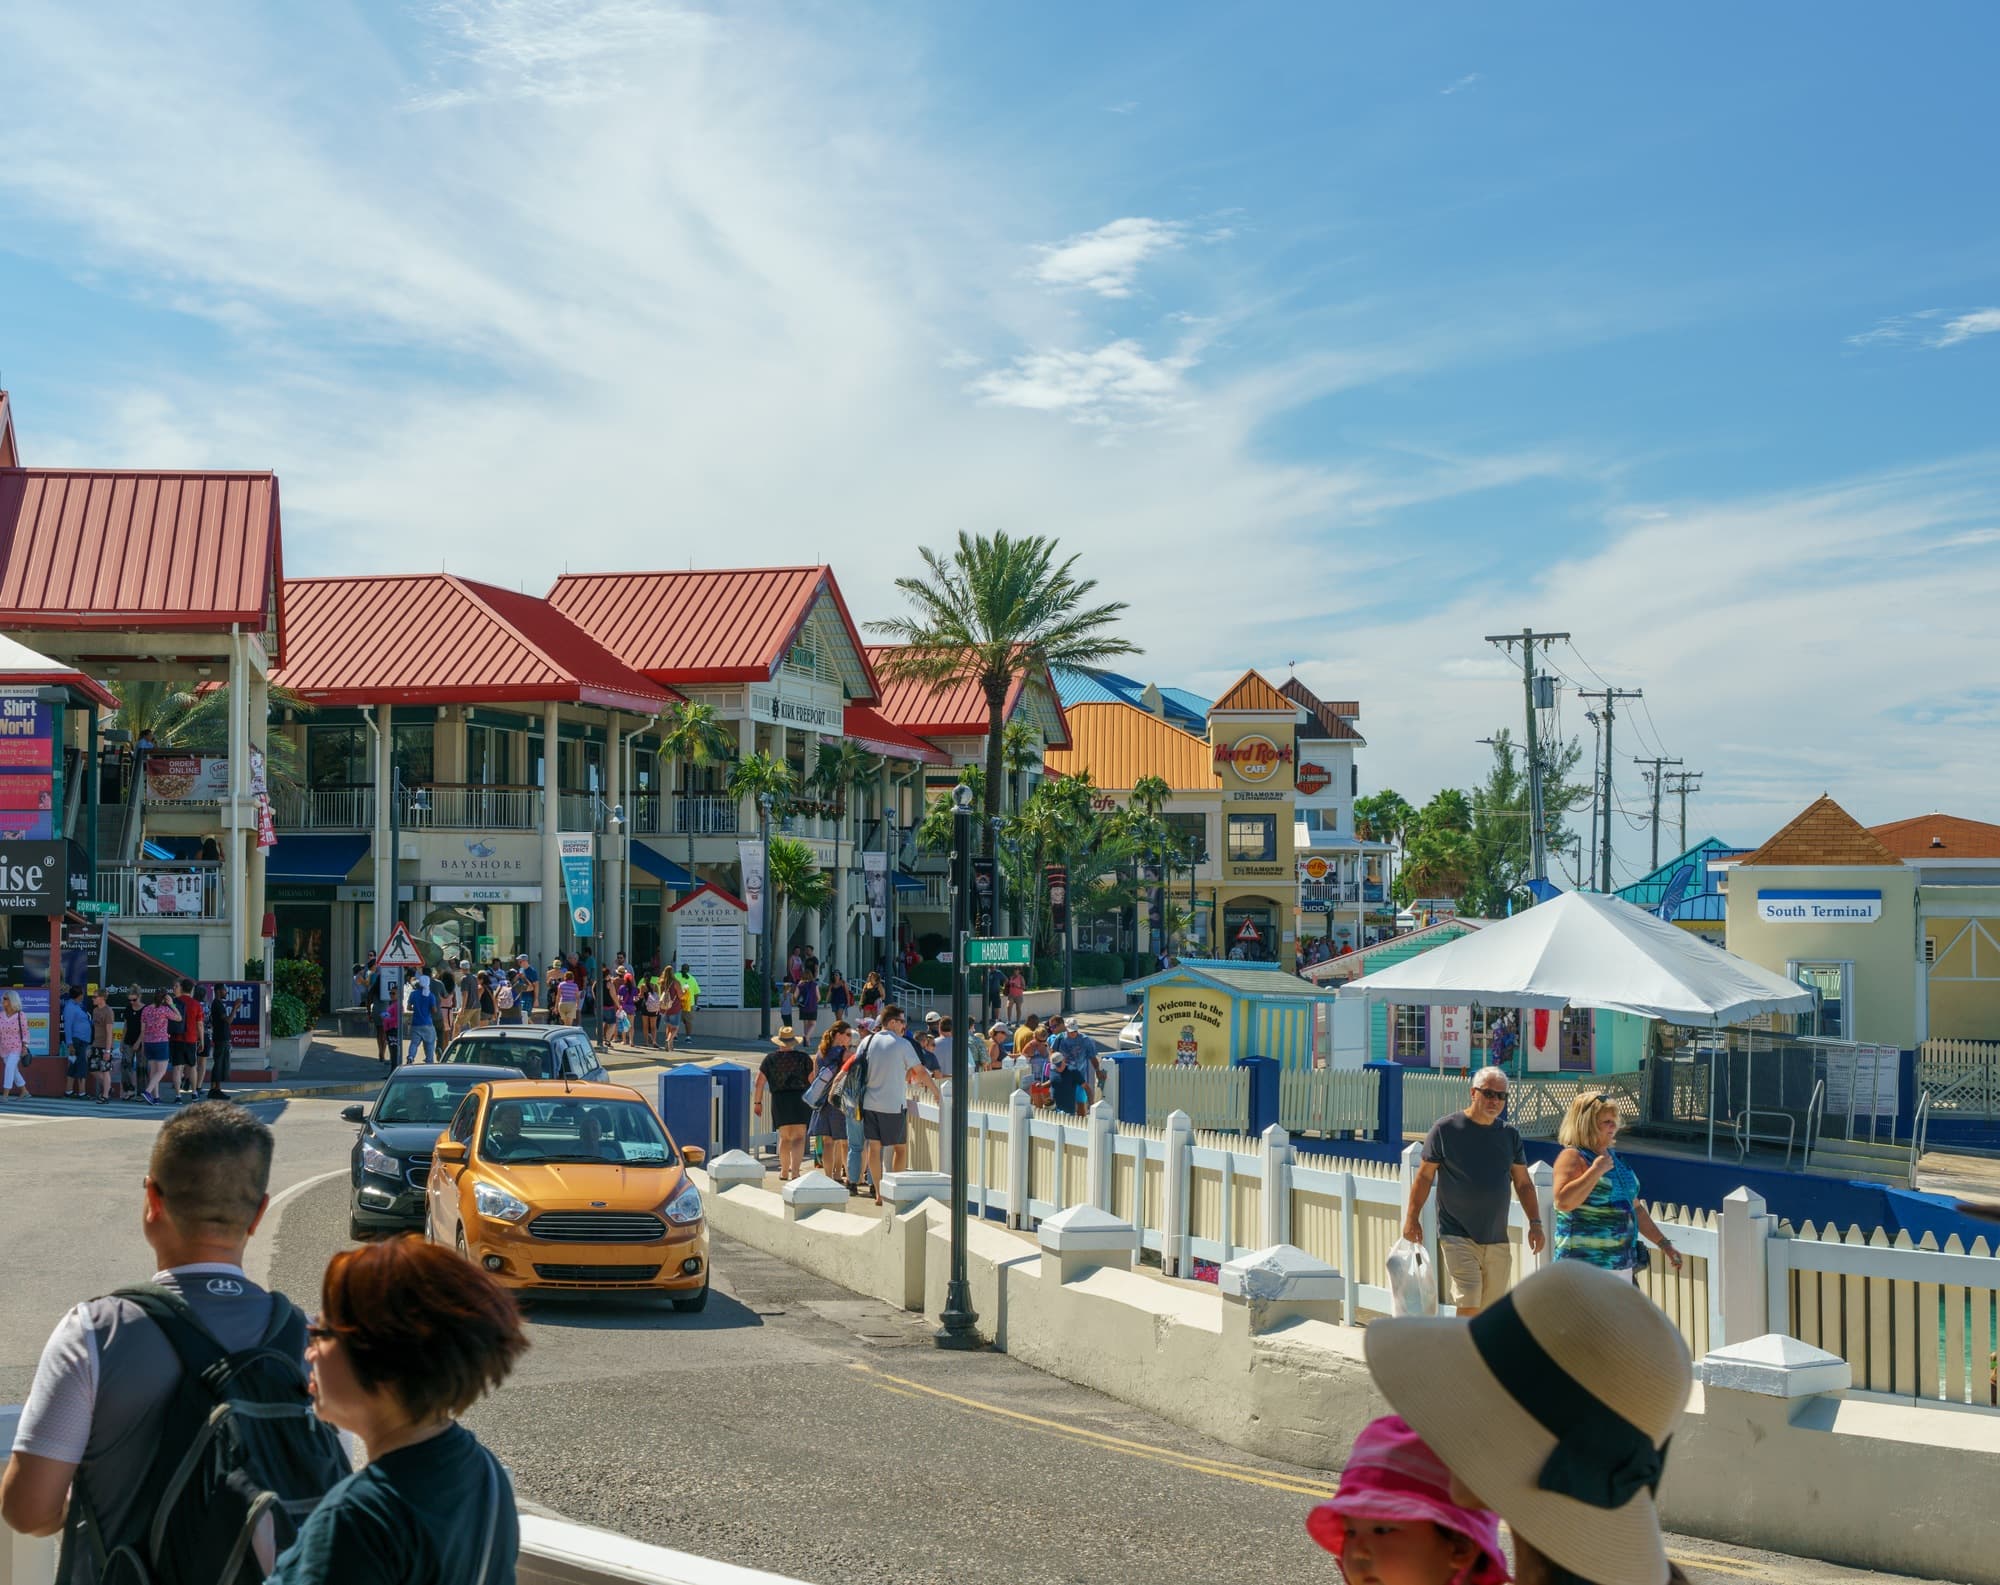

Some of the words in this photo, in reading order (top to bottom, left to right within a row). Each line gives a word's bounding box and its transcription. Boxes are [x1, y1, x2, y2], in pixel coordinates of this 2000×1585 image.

[4, 699, 38, 717] Shirt
[781, 703, 795, 720] KIRK
[796, 706, 826, 726] FREEPORT
[1214, 743, 1253, 762] Hard
[1255, 742, 1294, 765] Rock
[169, 767, 200, 775] ONLINE
[1244, 764, 1267, 774] CAFE
[441, 859, 522, 870] BAYSHORE
[464, 871, 497, 879] MALL
[472, 891, 501, 899] ROLEX
[77, 901, 101, 913] GORING
[680, 908, 738, 916] BAYSHORE
[1766, 905, 1806, 917] South
[1811, 905, 1872, 917] Terminal
[981, 942, 1009, 961] HARBOUR
[1157, 1000, 1197, 1013] Welcome
[1199, 1001, 1208, 1010] to
[1209, 1005, 1224, 1017] the
[1159, 1011, 1191, 1024] Cayman
[1193, 1010, 1221, 1028] Islands
[1446, 1018, 1453, 1028] 3
[1445, 1044, 1451, 1054] 1
